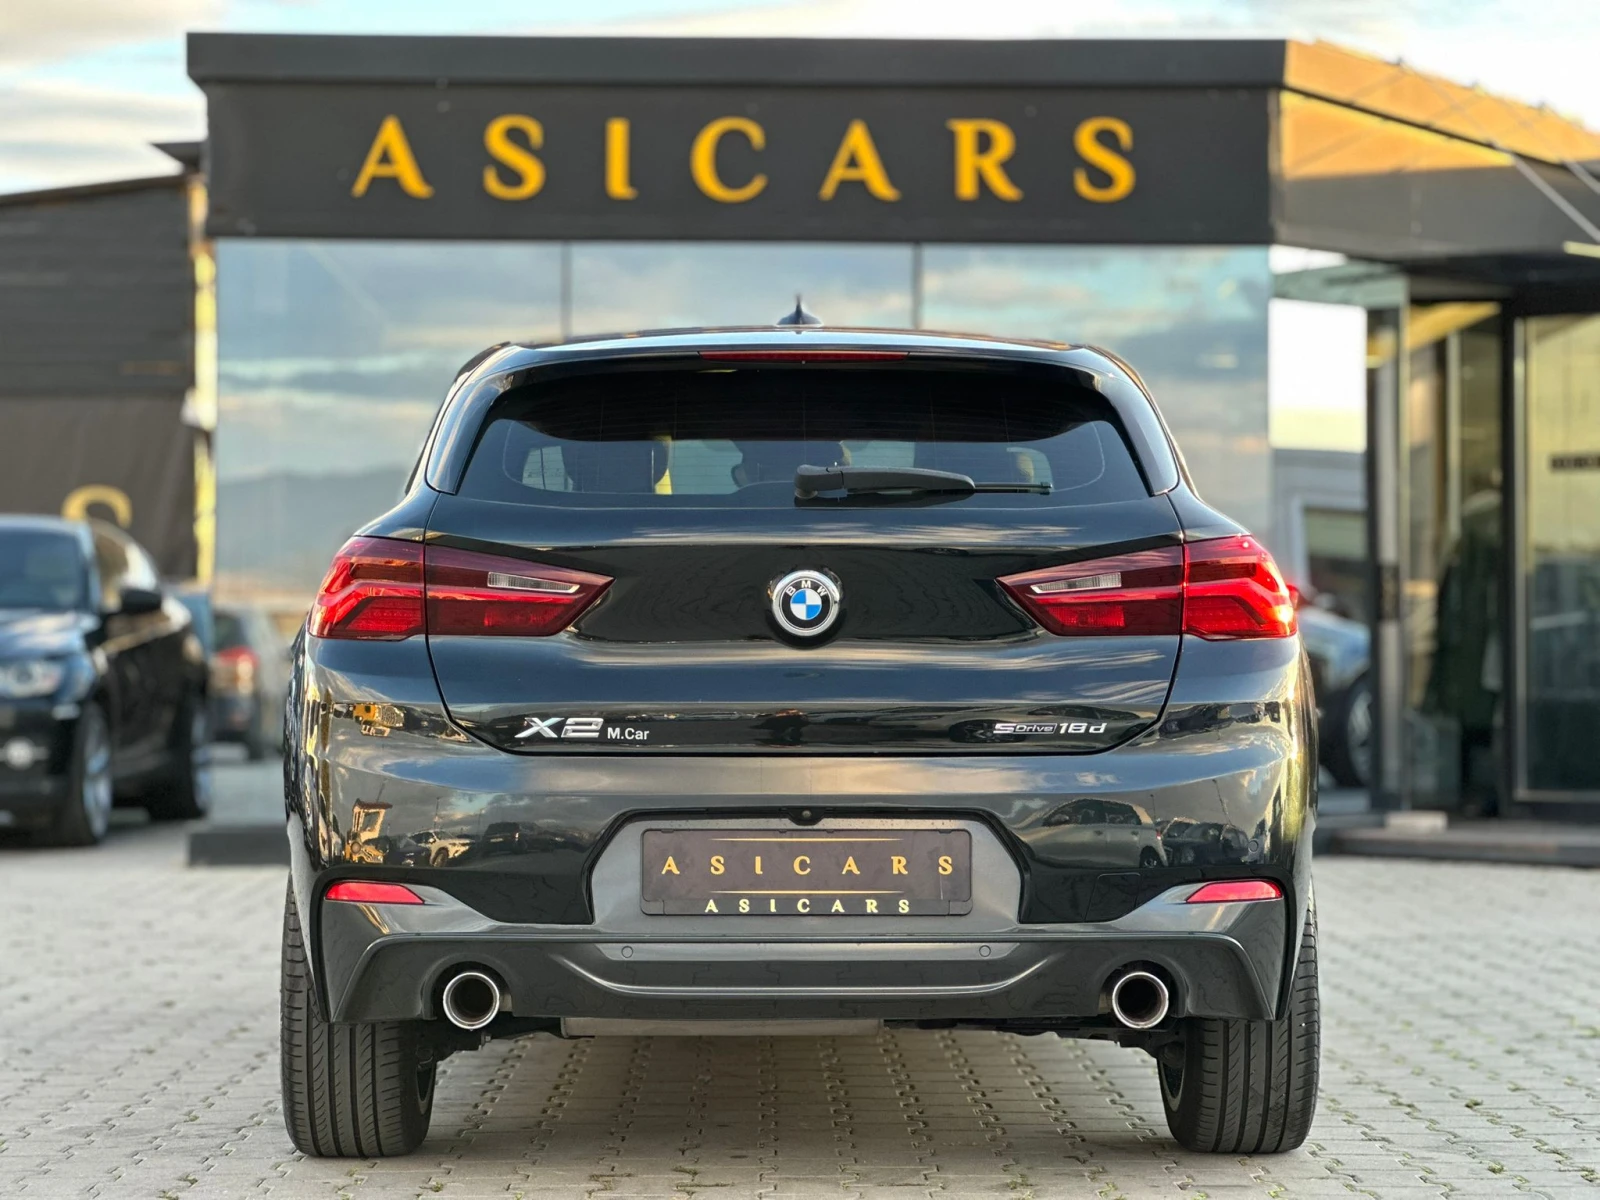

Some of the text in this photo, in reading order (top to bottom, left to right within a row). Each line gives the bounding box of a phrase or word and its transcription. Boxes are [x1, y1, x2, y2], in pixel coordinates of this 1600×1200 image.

[352, 114, 1137, 202] ASICARS
[785, 580, 829, 597] BMW
[514, 717, 650, 740] X2 M.Car
[661, 855, 954, 875] ASICARS
[704, 899, 910, 913] ASICARS
